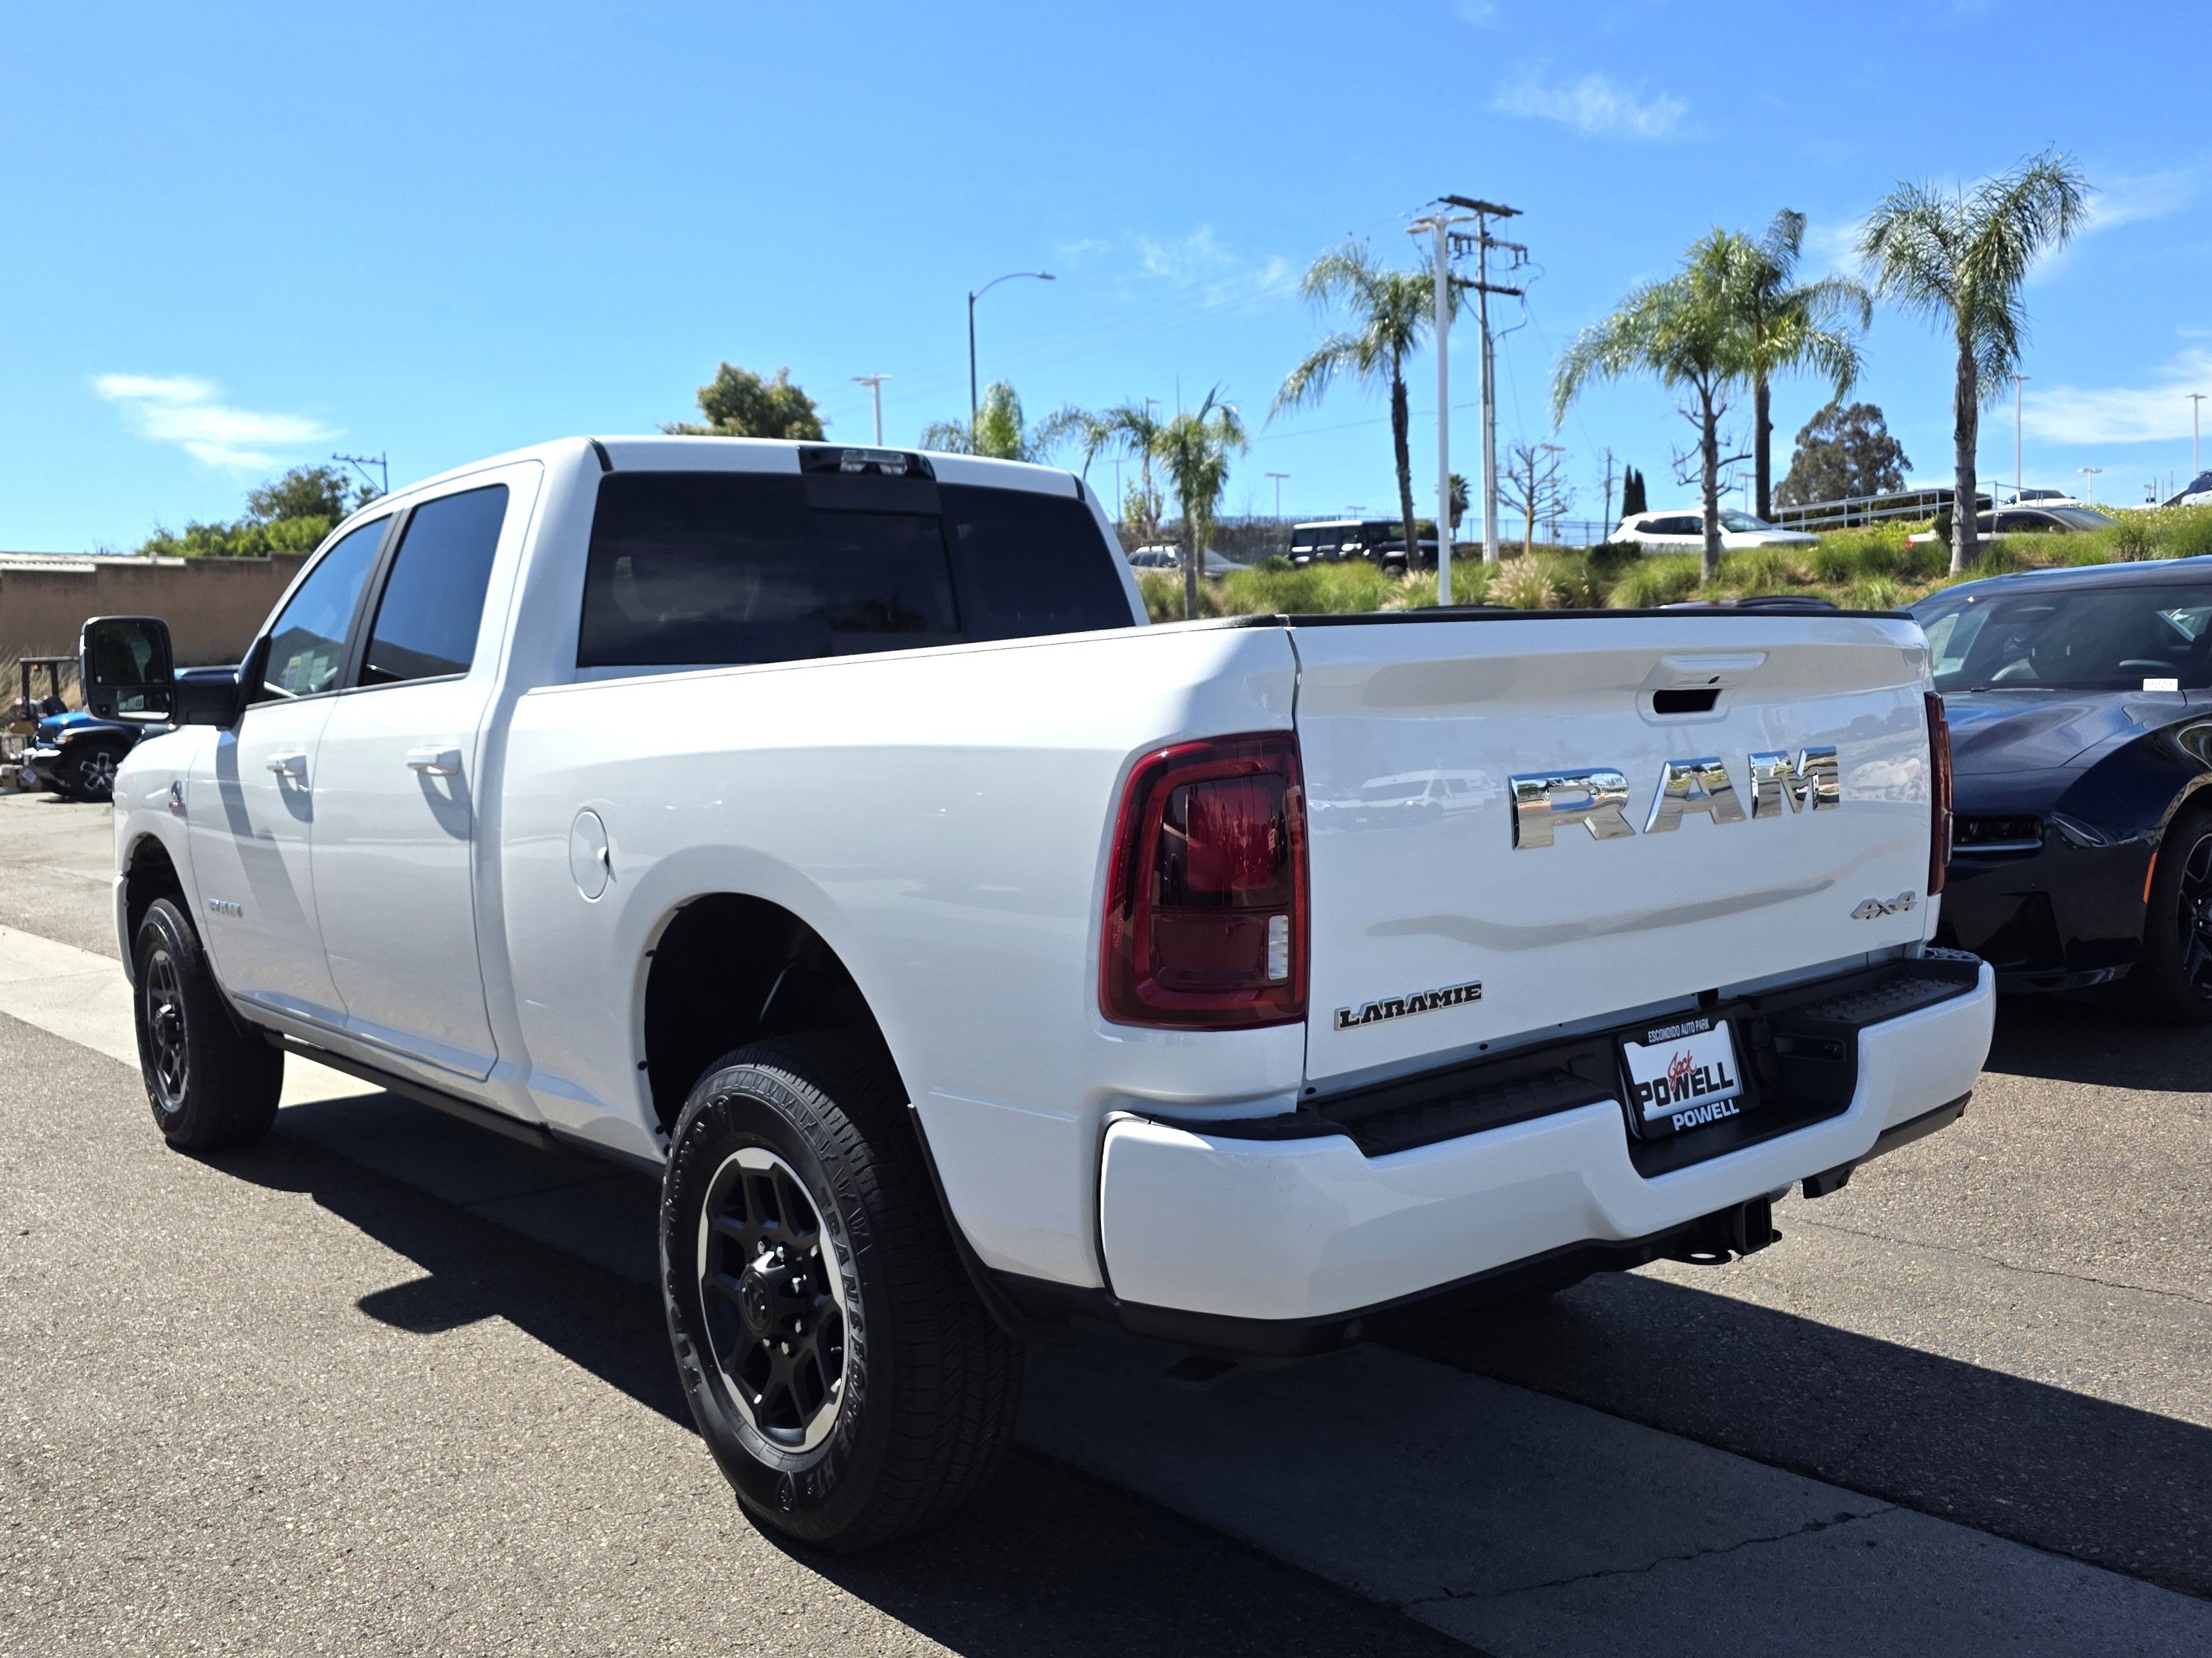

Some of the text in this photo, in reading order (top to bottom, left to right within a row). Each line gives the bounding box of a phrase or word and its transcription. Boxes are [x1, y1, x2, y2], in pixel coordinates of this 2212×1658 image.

[1508, 745, 1841, 851] RAM
[1850, 890, 1918, 920] 4x4
[1336, 981, 1483, 1030] LARAMIE
[1648, 1018, 1710, 1043] ESCONDIDO AUTO PARK
[1634, 1061, 1734, 1112] POWELL
[1667, 1049, 1697, 1092] Jack
[1672, 1098, 1740, 1131] POWELL
